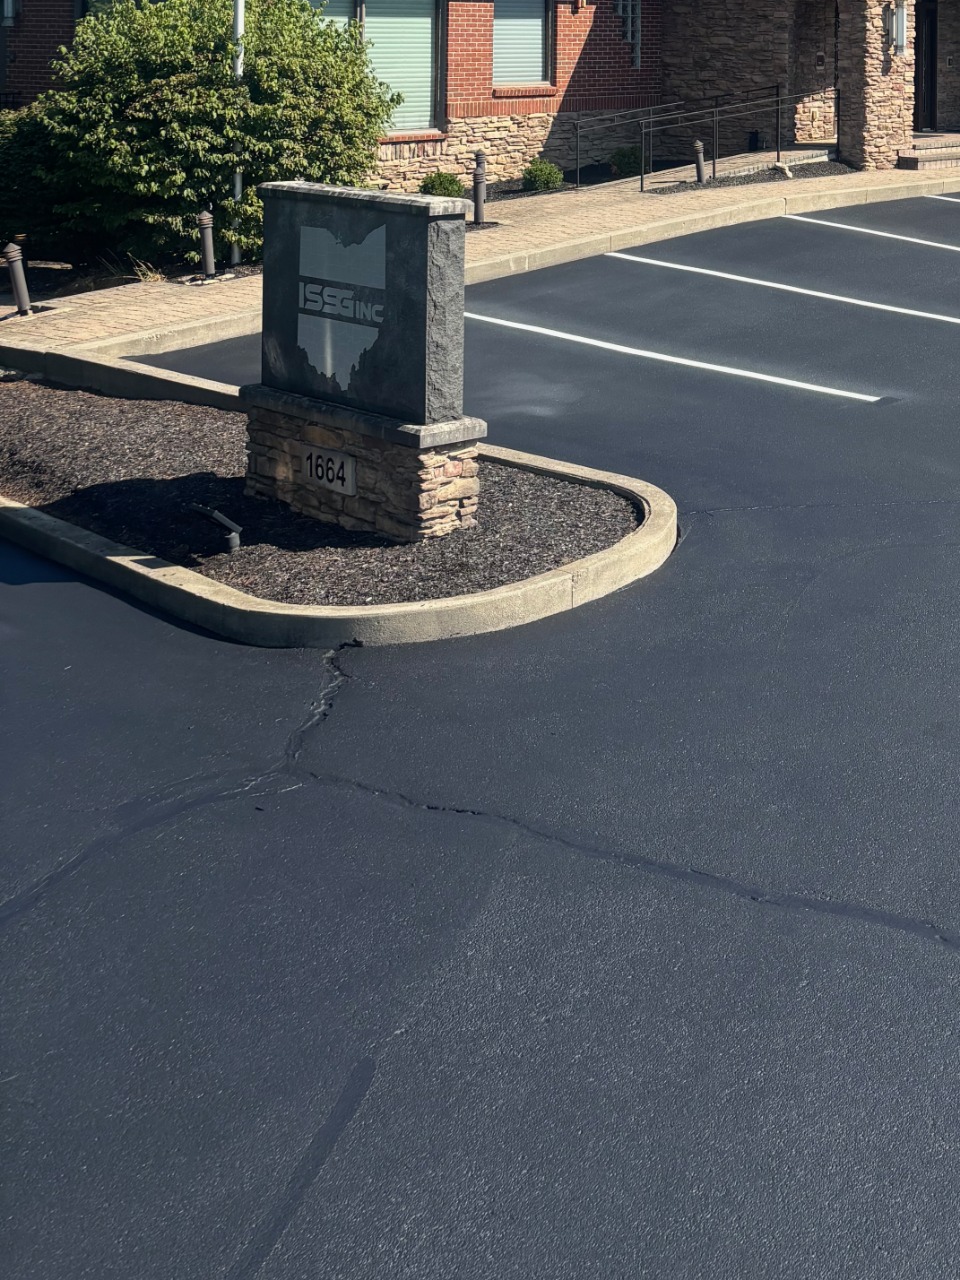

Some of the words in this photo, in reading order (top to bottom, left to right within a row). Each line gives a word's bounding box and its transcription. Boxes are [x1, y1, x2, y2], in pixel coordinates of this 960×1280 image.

[299, 282, 354, 318] ISSG
[355, 300, 384, 323] INC
[306, 452, 347, 487] 1664
